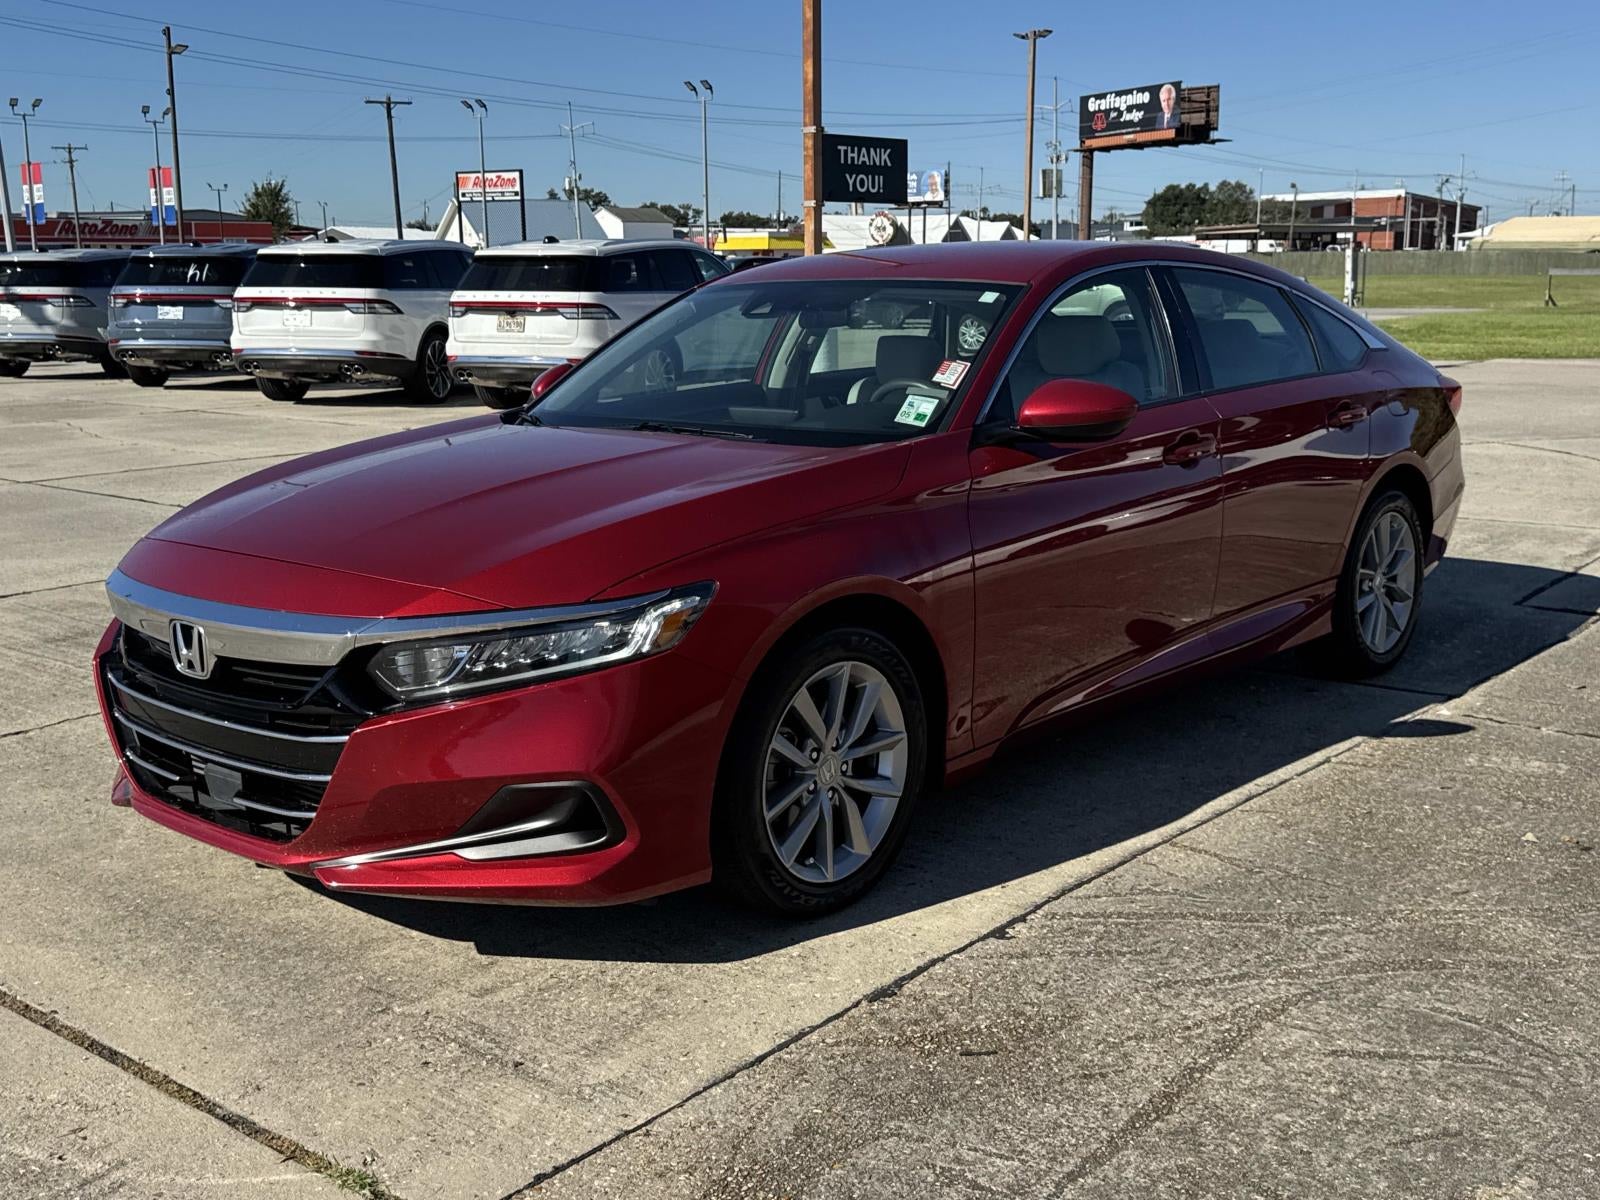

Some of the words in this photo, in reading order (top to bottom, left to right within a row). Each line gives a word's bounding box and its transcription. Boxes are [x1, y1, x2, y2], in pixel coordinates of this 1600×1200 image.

[1087, 89, 1151, 112] Graffagnino
[1120, 108, 1144, 123] Judge
[837, 145, 892, 167] THANK
[845, 173, 884, 193] YOU!
[57, 219, 139, 236] AutoZone
[900, 410, 911, 418] 05
